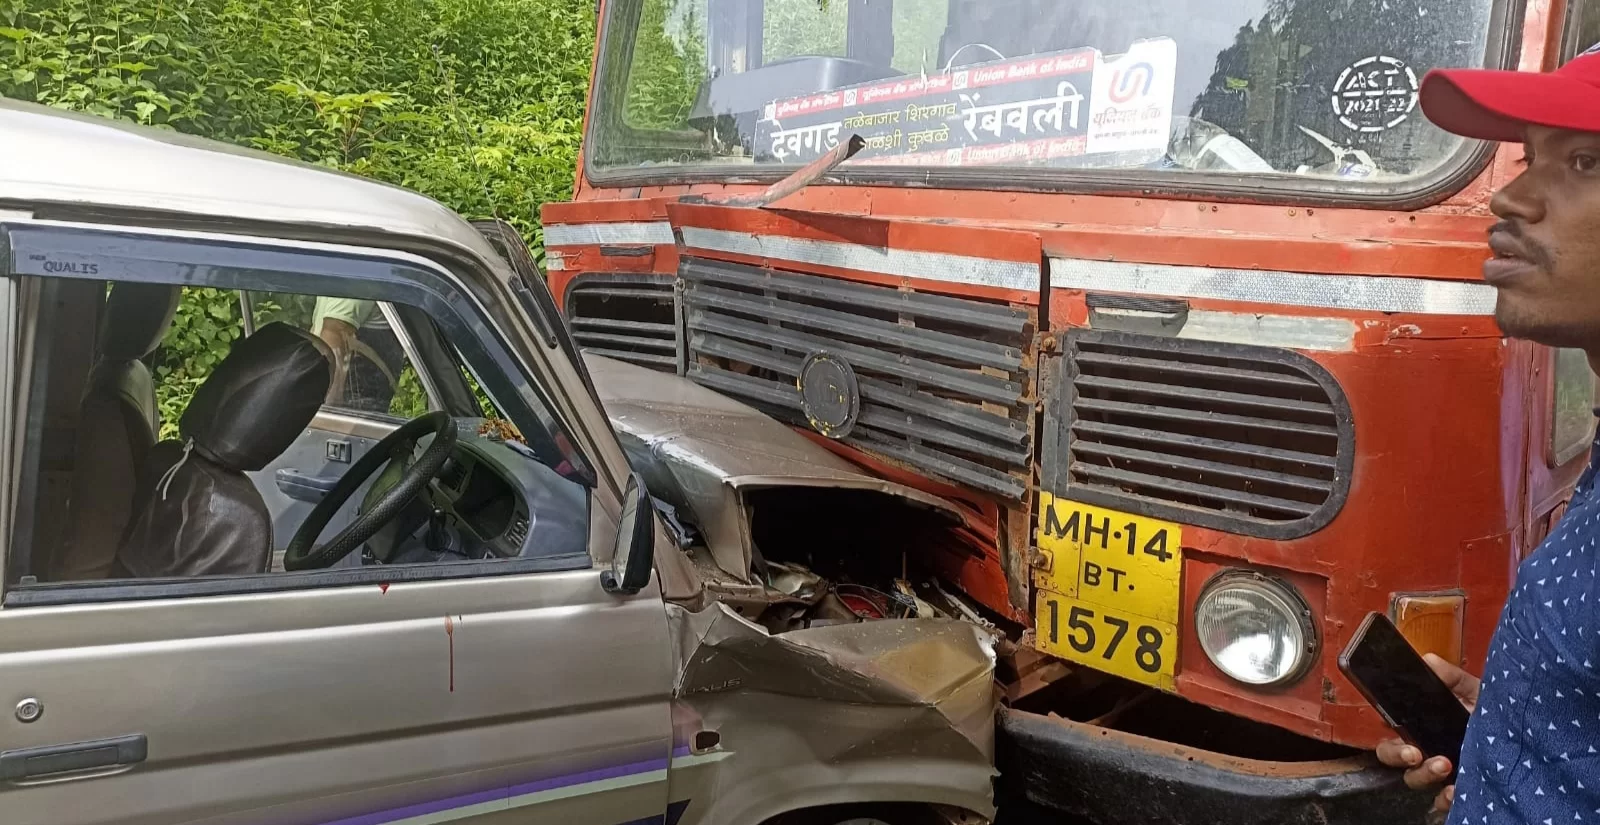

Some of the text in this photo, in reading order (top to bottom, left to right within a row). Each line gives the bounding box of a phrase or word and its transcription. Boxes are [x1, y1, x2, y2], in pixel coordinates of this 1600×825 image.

[972, 67, 1006, 83] Union
[1008, 61, 1037, 78] Bank
[1056, 55, 1088, 70] India
[1345, 68, 1400, 90] ACT
[958, 80, 1085, 142] रेंबवली
[1344, 97, 1405, 115] 2021-22
[843, 111, 900, 130] तळेबाजार
[769, 118, 842, 164] देवगड
[42, 260, 98, 275] QUALIS
[1047, 600, 1164, 674] 1578
